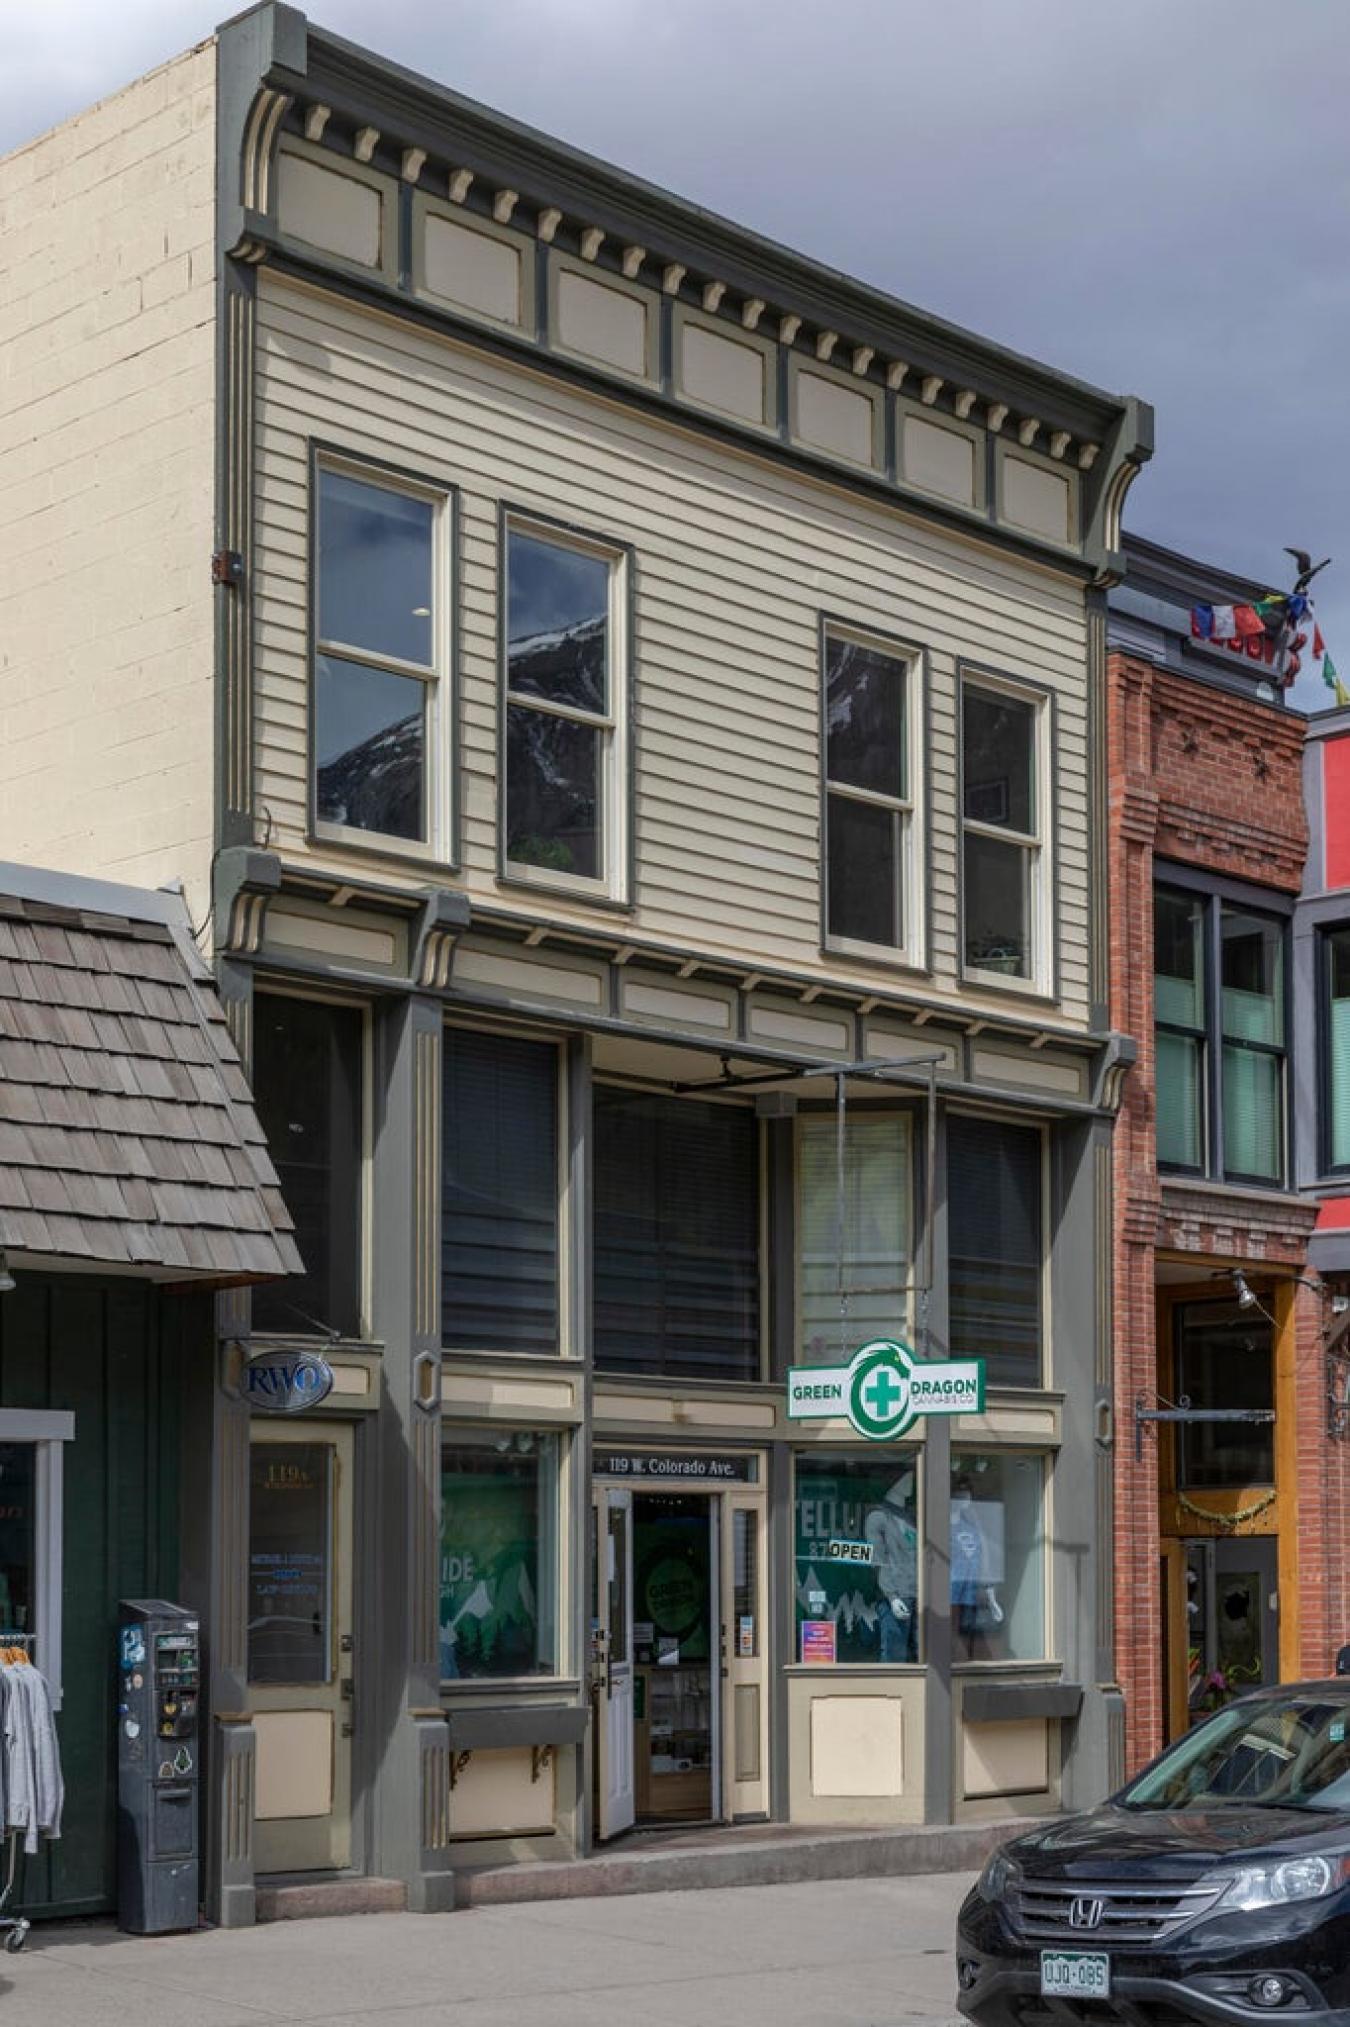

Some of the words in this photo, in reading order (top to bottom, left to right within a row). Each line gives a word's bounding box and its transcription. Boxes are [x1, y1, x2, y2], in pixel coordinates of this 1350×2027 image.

[248, 1362, 321, 1395] RWO
[910, 1379, 976, 1395] DRAGON
[793, 1384, 842, 1400] GREEN
[609, 1456, 628, 1472] 119
[630, 1457, 646, 1473] W.
[648, 1458, 706, 1474] Colorado
[708, 1460, 736, 1476] Ave.
[831, 1543, 870, 1561] OPEN
